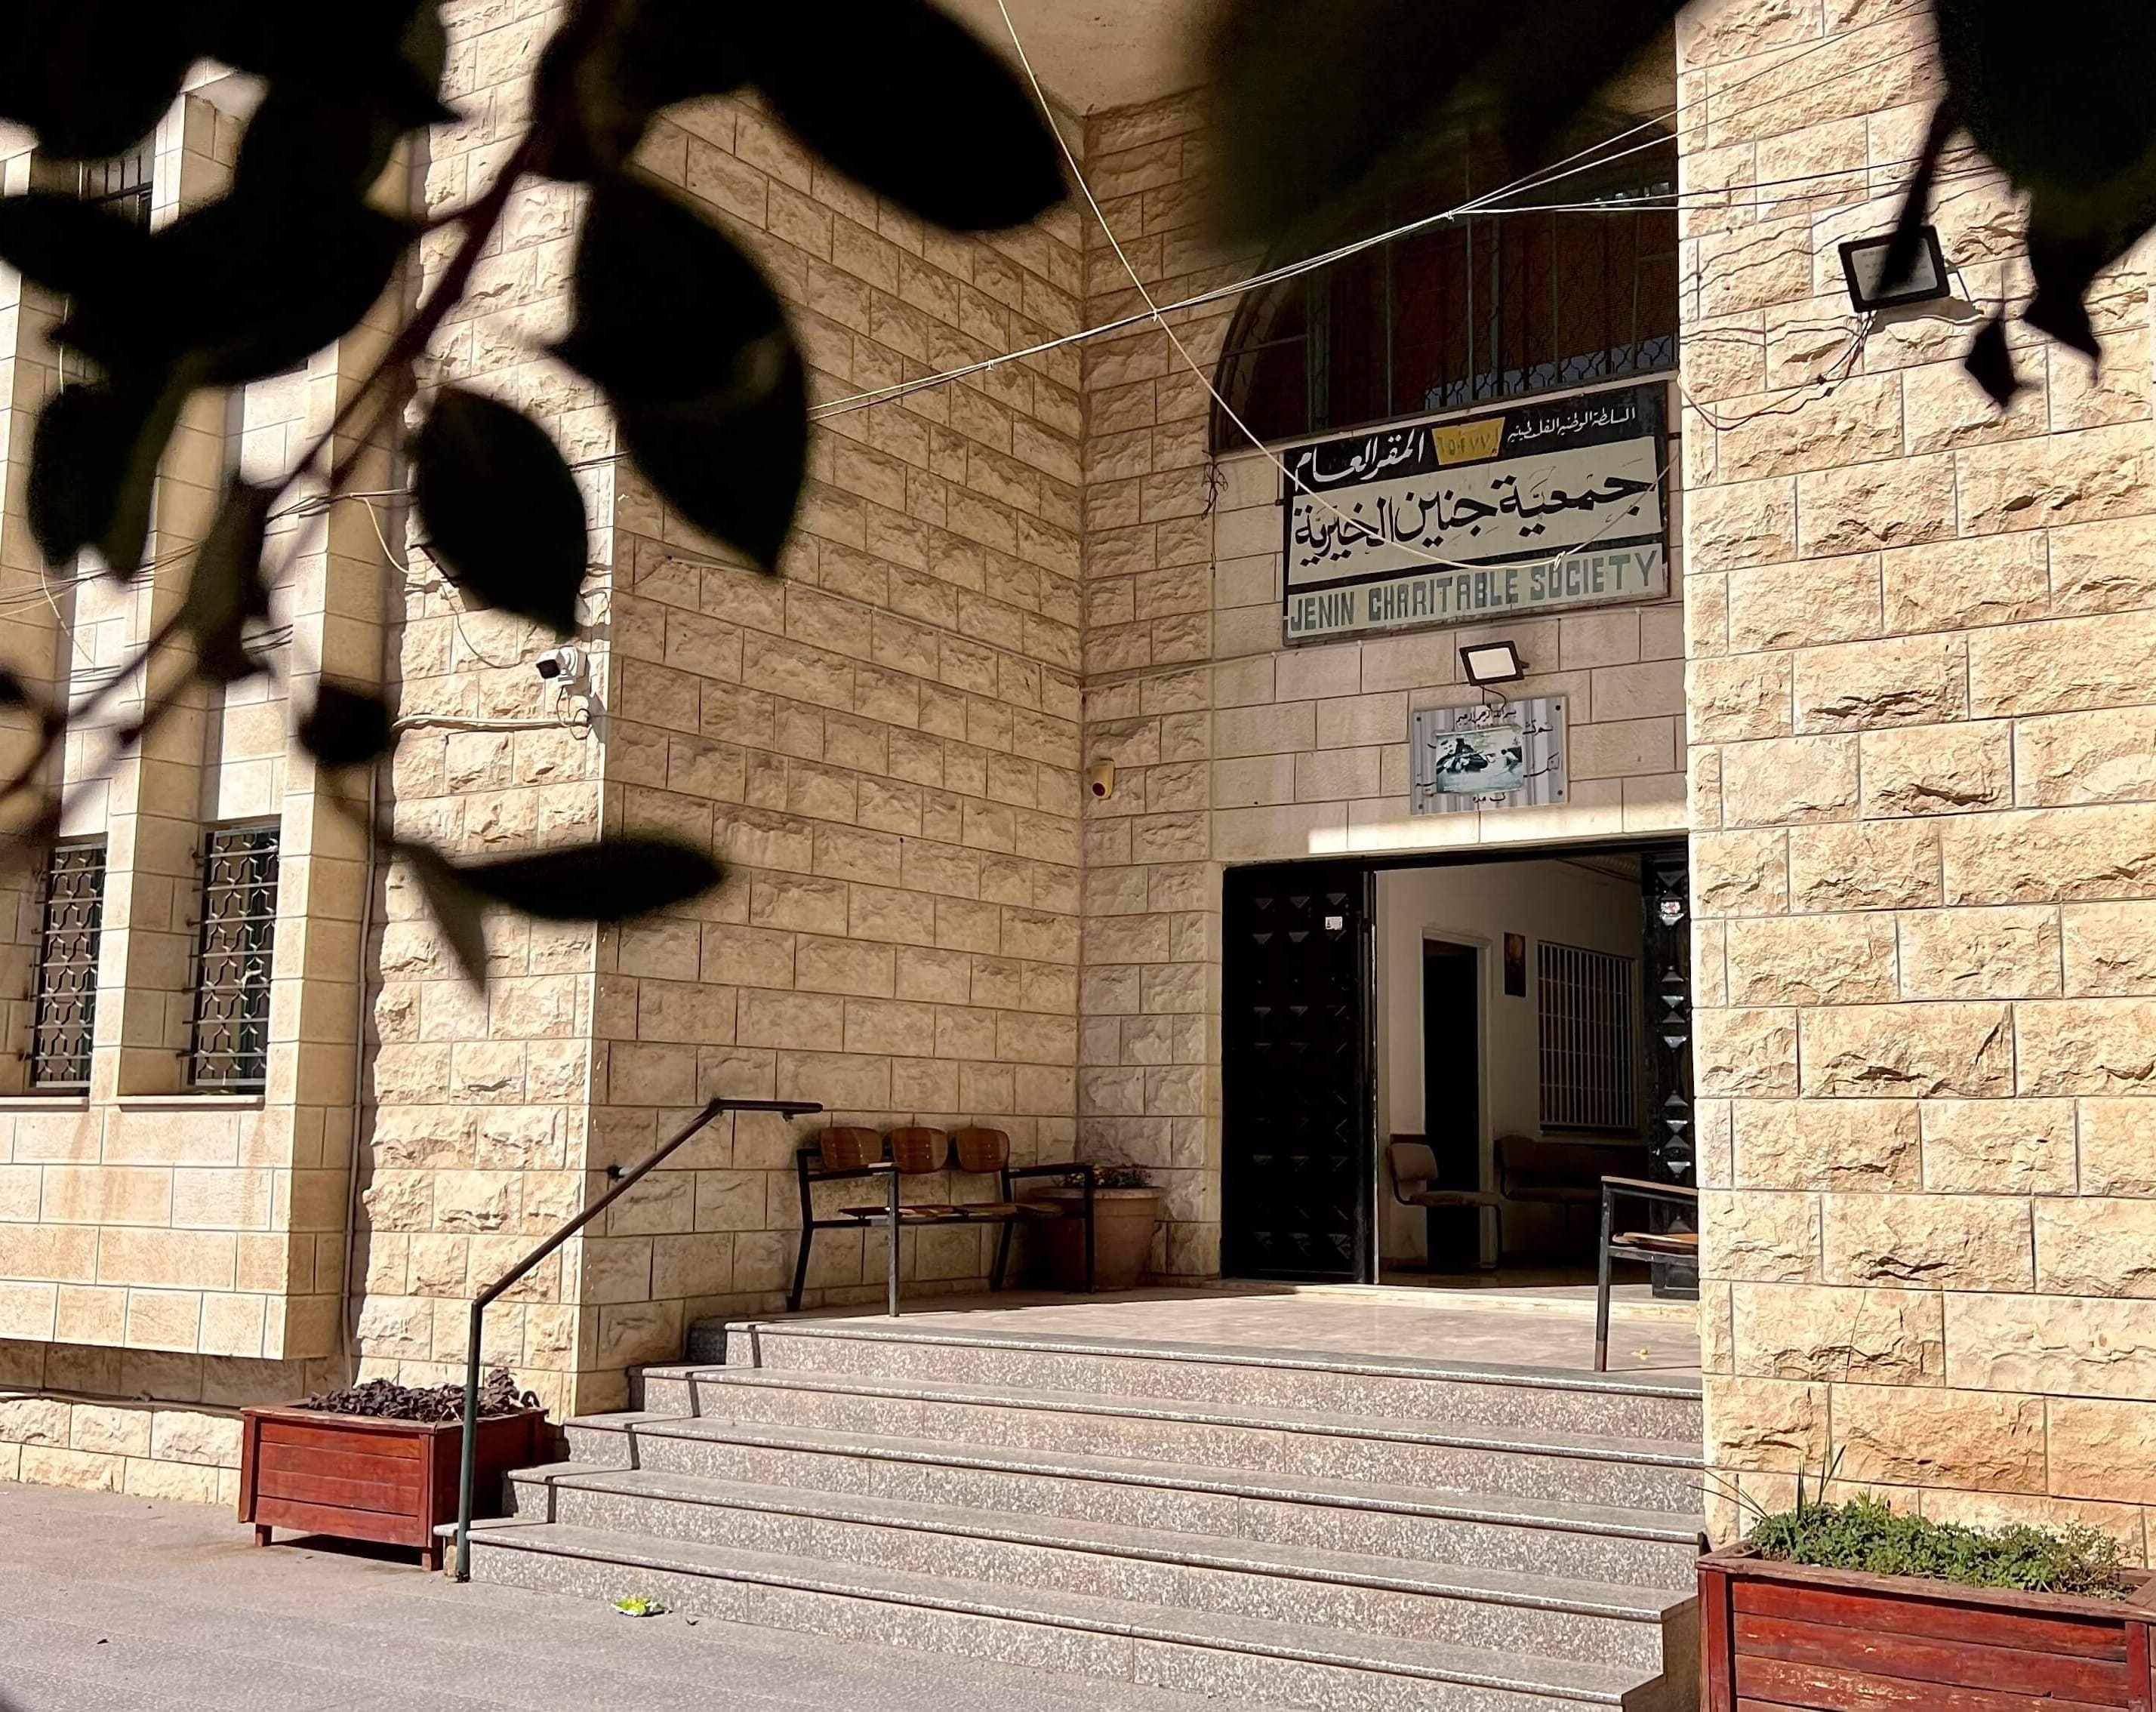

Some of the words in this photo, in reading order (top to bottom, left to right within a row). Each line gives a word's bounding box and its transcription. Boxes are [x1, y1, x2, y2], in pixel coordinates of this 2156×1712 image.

[1294, 435, 1379, 492] العام
[1360, 427, 1425, 481] المقر
[1294, 495, 1396, 567] الخيرية
[1394, 489, 1498, 550] جنين
[1490, 473, 1656, 537] جمعية
[1290, 591, 1355, 632] JENIN
[1368, 568, 1519, 622] CHARITABLE
[1530, 550, 1657, 601] SOCIETY
